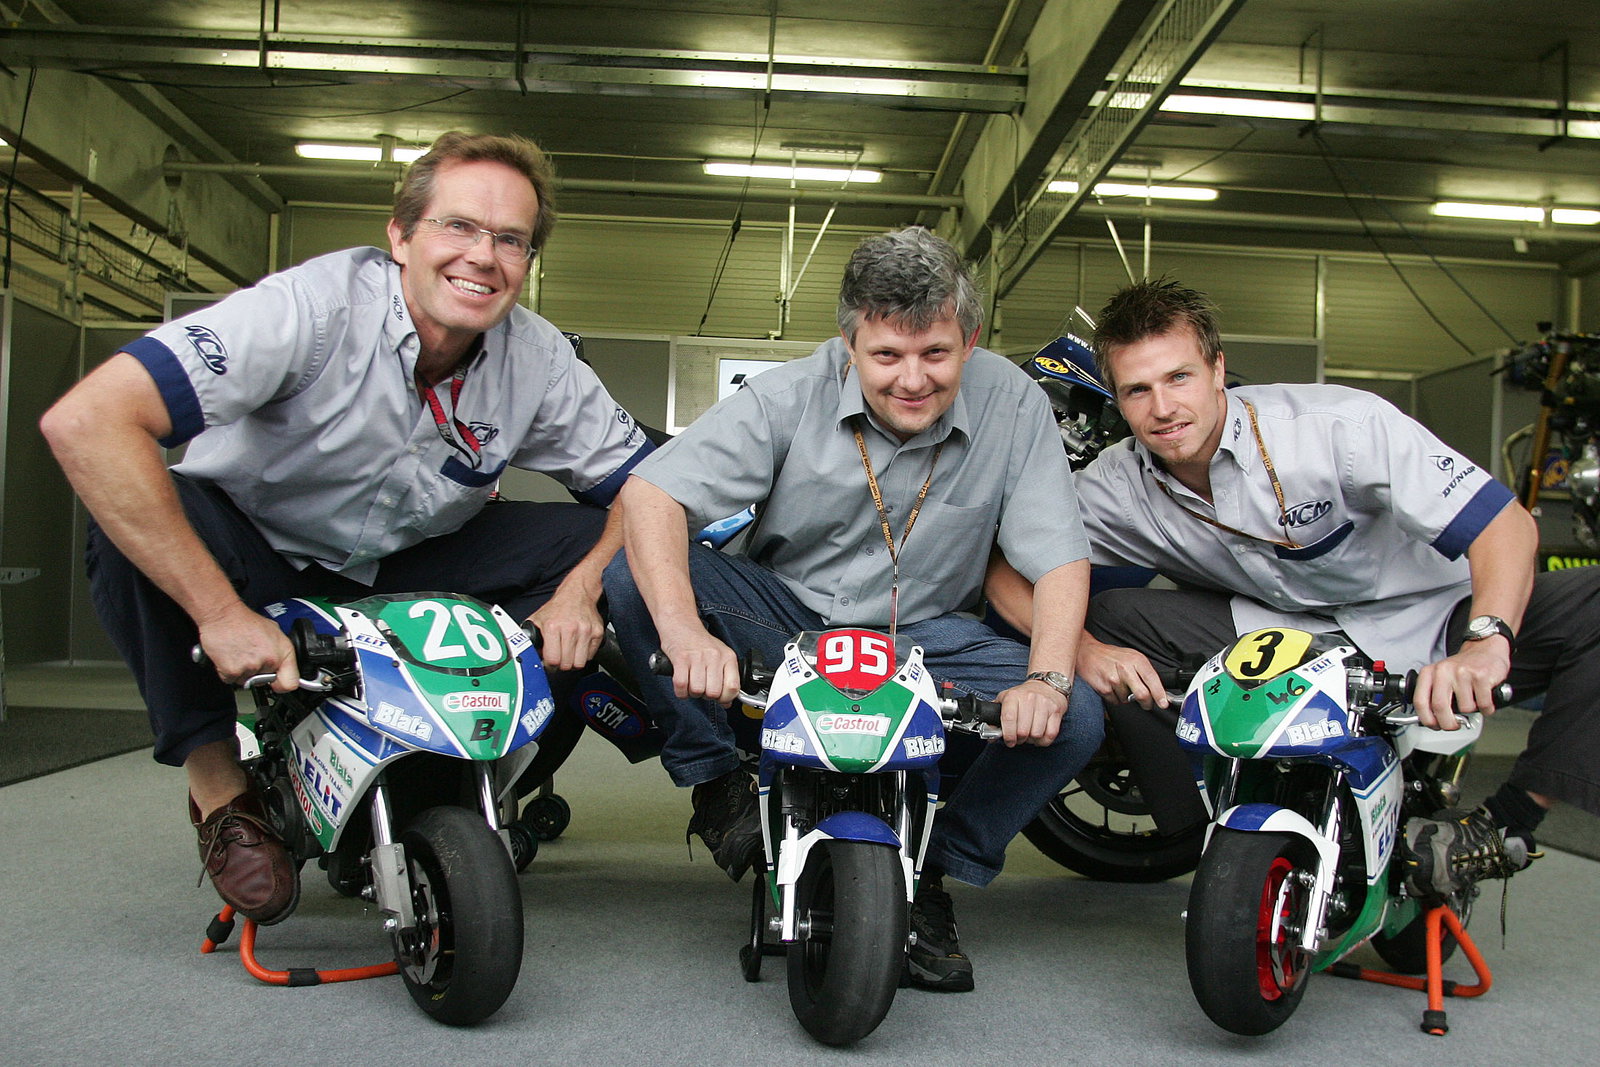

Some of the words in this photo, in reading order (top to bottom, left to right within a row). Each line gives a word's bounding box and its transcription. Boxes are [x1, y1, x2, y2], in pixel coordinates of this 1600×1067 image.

[1442, 465, 1476, 498] DUNLOP
[408, 600, 503, 662] 26
[825, 635, 888, 676] 95
[1240, 631, 1285, 677] 3
[461, 695, 503, 708] Castrol
[1266, 677, 1306, 705] 46
[374, 702, 433, 741] Blata
[520, 698, 554, 736] Blata
[596, 702, 629, 729] STM
[833, 716, 880, 732] Castrol
[761, 728, 805, 755] Blata
[902, 735, 945, 758] Blata
[1286, 718, 1344, 746] Blata
[329, 748, 354, 788] Blata
